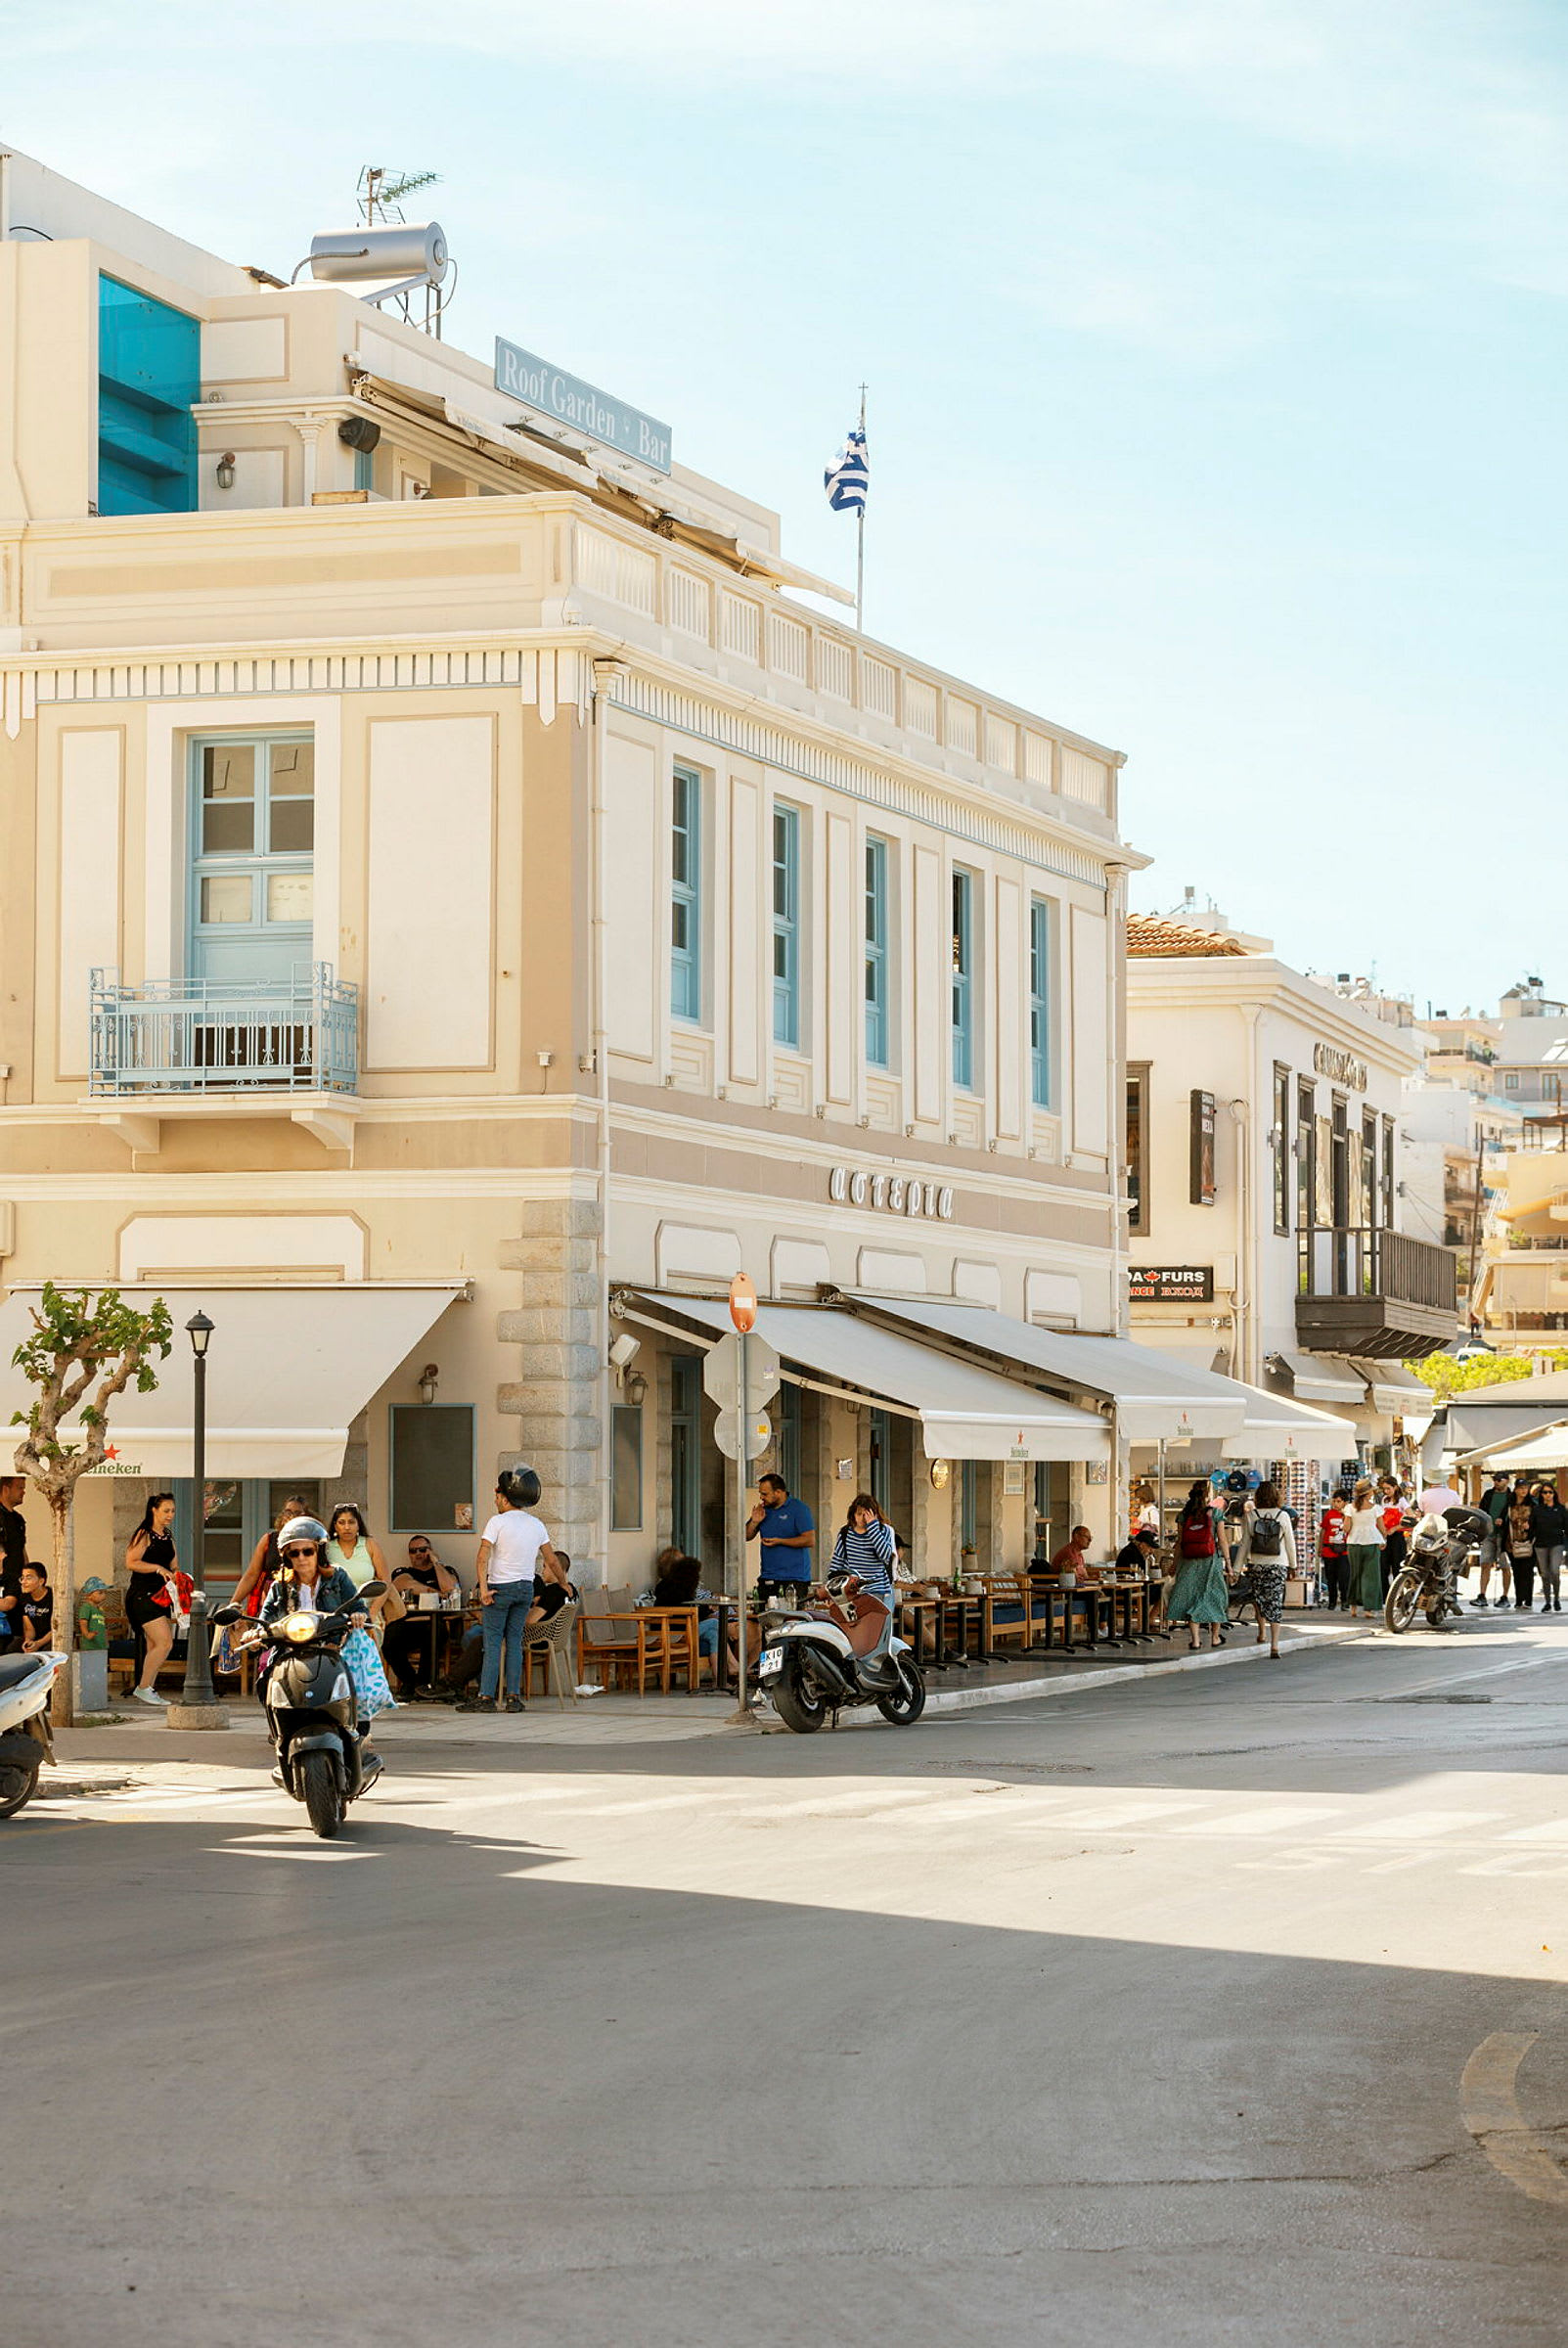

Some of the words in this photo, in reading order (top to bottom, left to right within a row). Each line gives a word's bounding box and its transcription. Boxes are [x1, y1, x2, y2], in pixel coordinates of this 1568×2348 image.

[504, 348, 548, 404] Roof
[552, 376, 615, 438] Garden
[638, 419, 668, 464] Bar
[1161, 1271, 1205, 1283] FURS
[86, 1463, 141, 1474] ineken
